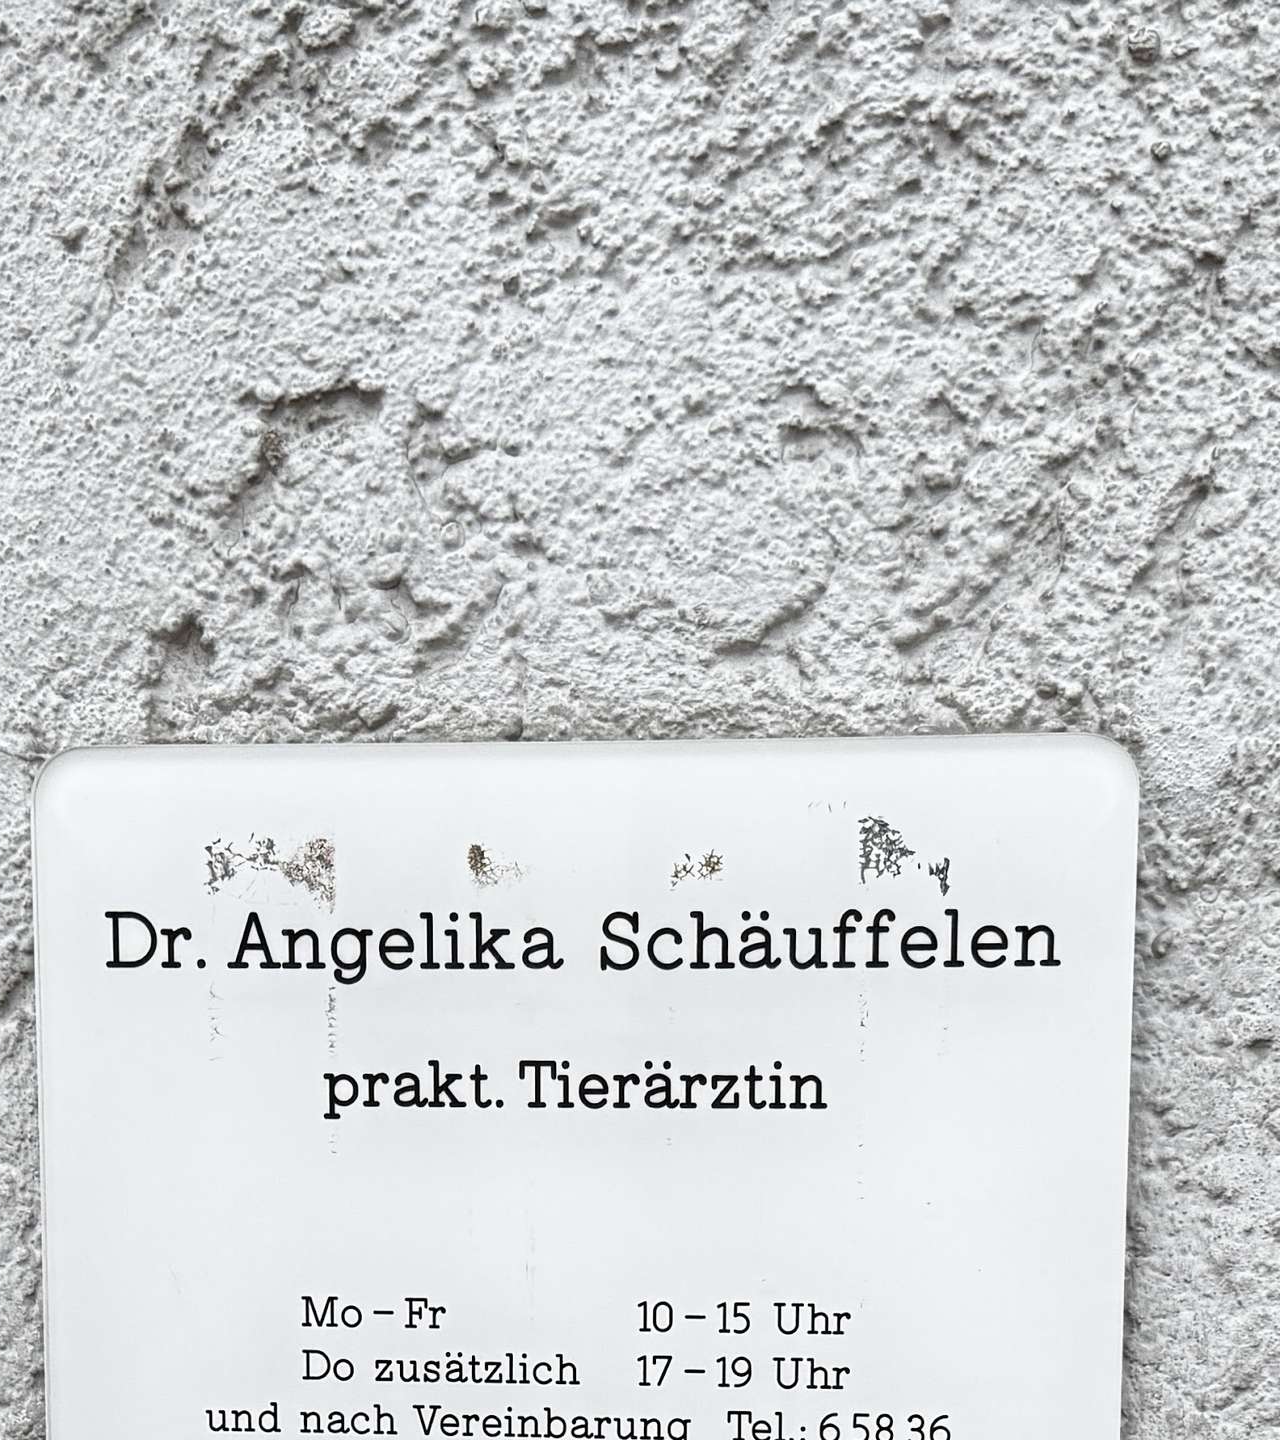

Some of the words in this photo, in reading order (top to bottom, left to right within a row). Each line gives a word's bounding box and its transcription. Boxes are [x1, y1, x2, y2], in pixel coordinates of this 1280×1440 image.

[105, 912, 206, 969] Dr.
[227, 911, 564, 985] Angelika
[601, 909, 1061, 970] Schäuffelen
[324, 1060, 503, 1119] prakt.
[519, 1060, 827, 1110] Tierärztin
[773, 1302, 851, 1335] Uhr
[302, 1350, 354, 1381] Do
[375, 1351, 580, 1385] zusätzlich
[773, 1357, 851, 1390] Uhr
[206, 1402, 281, 1432] und
[300, 1403, 397, 1434] nach
